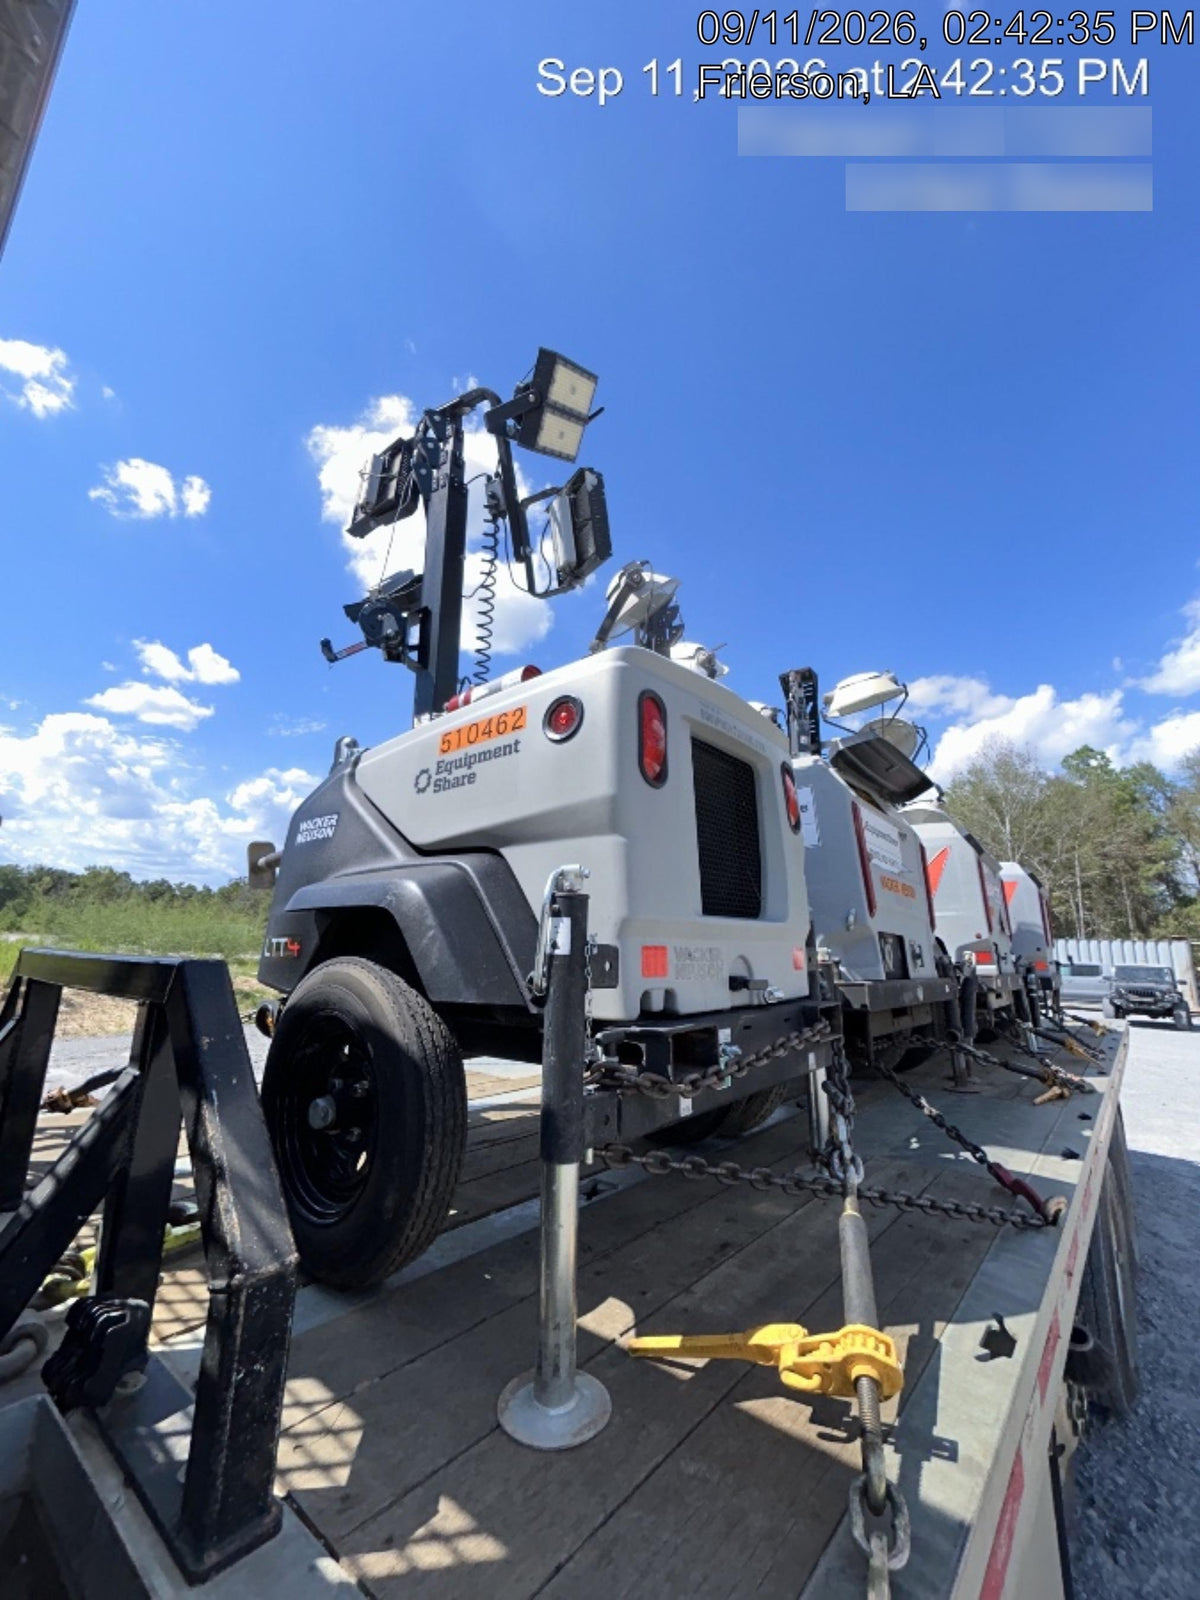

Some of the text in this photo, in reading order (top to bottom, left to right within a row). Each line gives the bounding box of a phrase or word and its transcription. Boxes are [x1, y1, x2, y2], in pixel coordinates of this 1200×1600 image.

[439, 706, 525, 755] 510462
[435, 739, 521, 776] Equipment
[433, 772, 477, 793] Share
